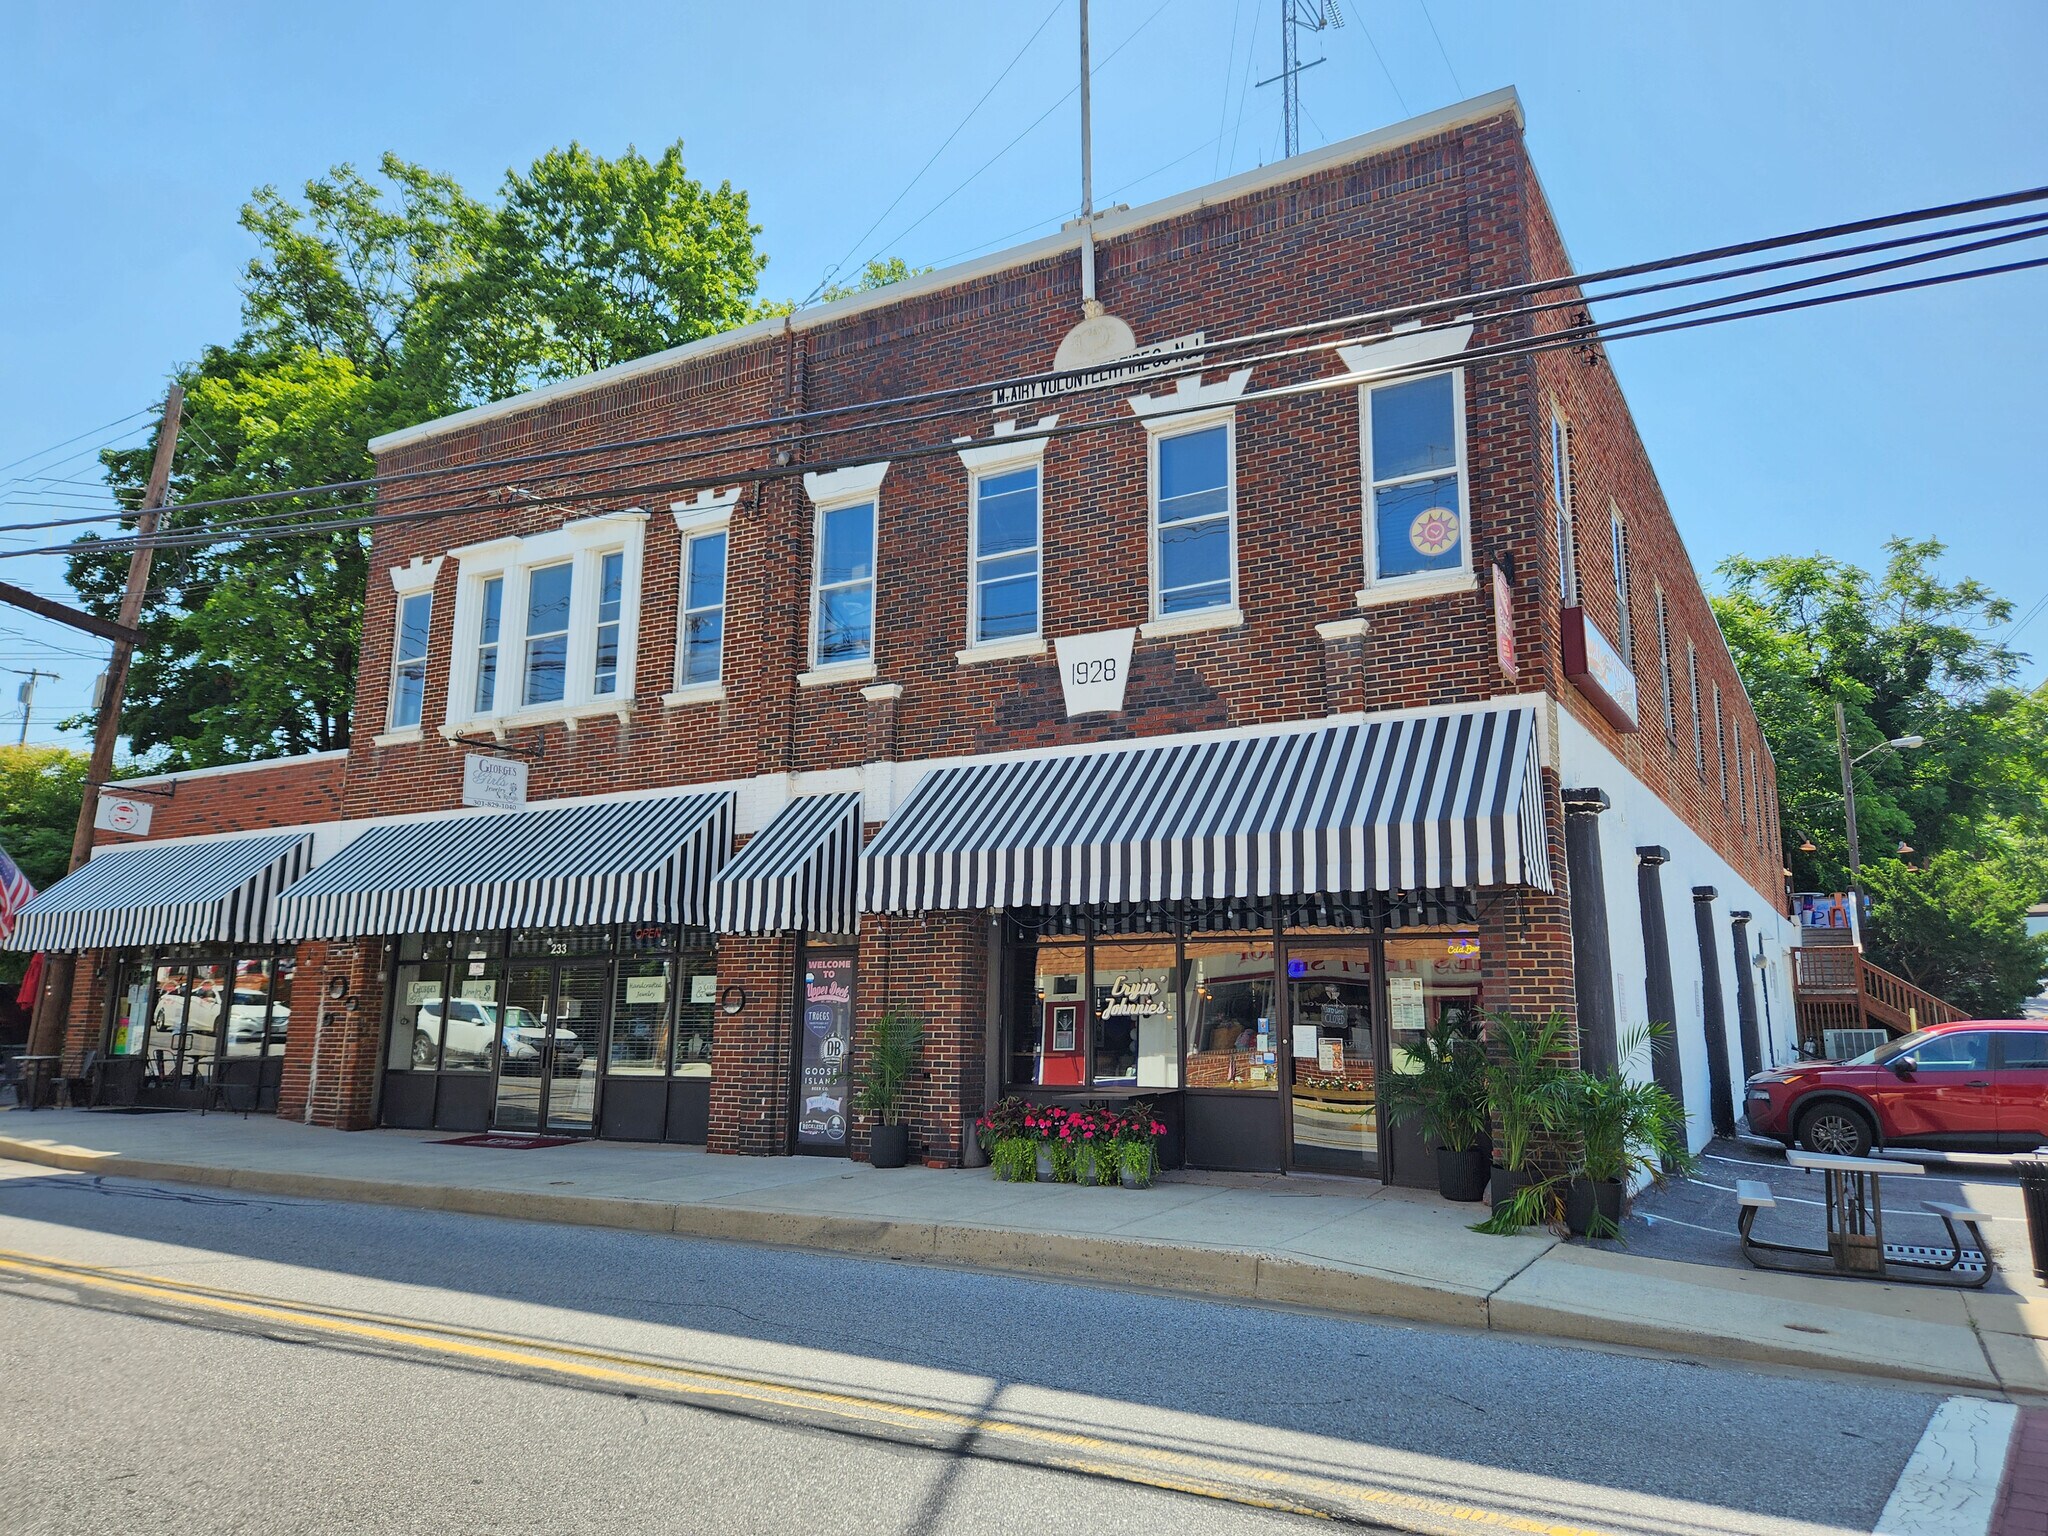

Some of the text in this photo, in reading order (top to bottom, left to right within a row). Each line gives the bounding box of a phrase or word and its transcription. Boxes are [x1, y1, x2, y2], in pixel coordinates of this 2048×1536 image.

[1010, 382, 1036, 401] AIRY
[1072, 658, 1116, 685] 1928
[473, 770, 508, 787] Girls
[635, 928, 663, 940] OPEN
[550, 943, 567, 954] 233
[1447, 945, 1465, 954] Cold
[808, 960, 851, 969] WELCOME
[823, 970, 835, 978] TO
[806, 981, 849, 999] Upper Deck
[1112, 975, 1167, 1000] Cryin'
[1102, 997, 1168, 1021] Johnnies
[1325, 1013, 1345, 1025] CLOSED
[827, 1040, 841, 1056] DB
[804, 1067, 838, 1075] GOOSE
[804, 1077, 838, 1085] ISLAND
[802, 1123, 824, 1131] RECKLESS
